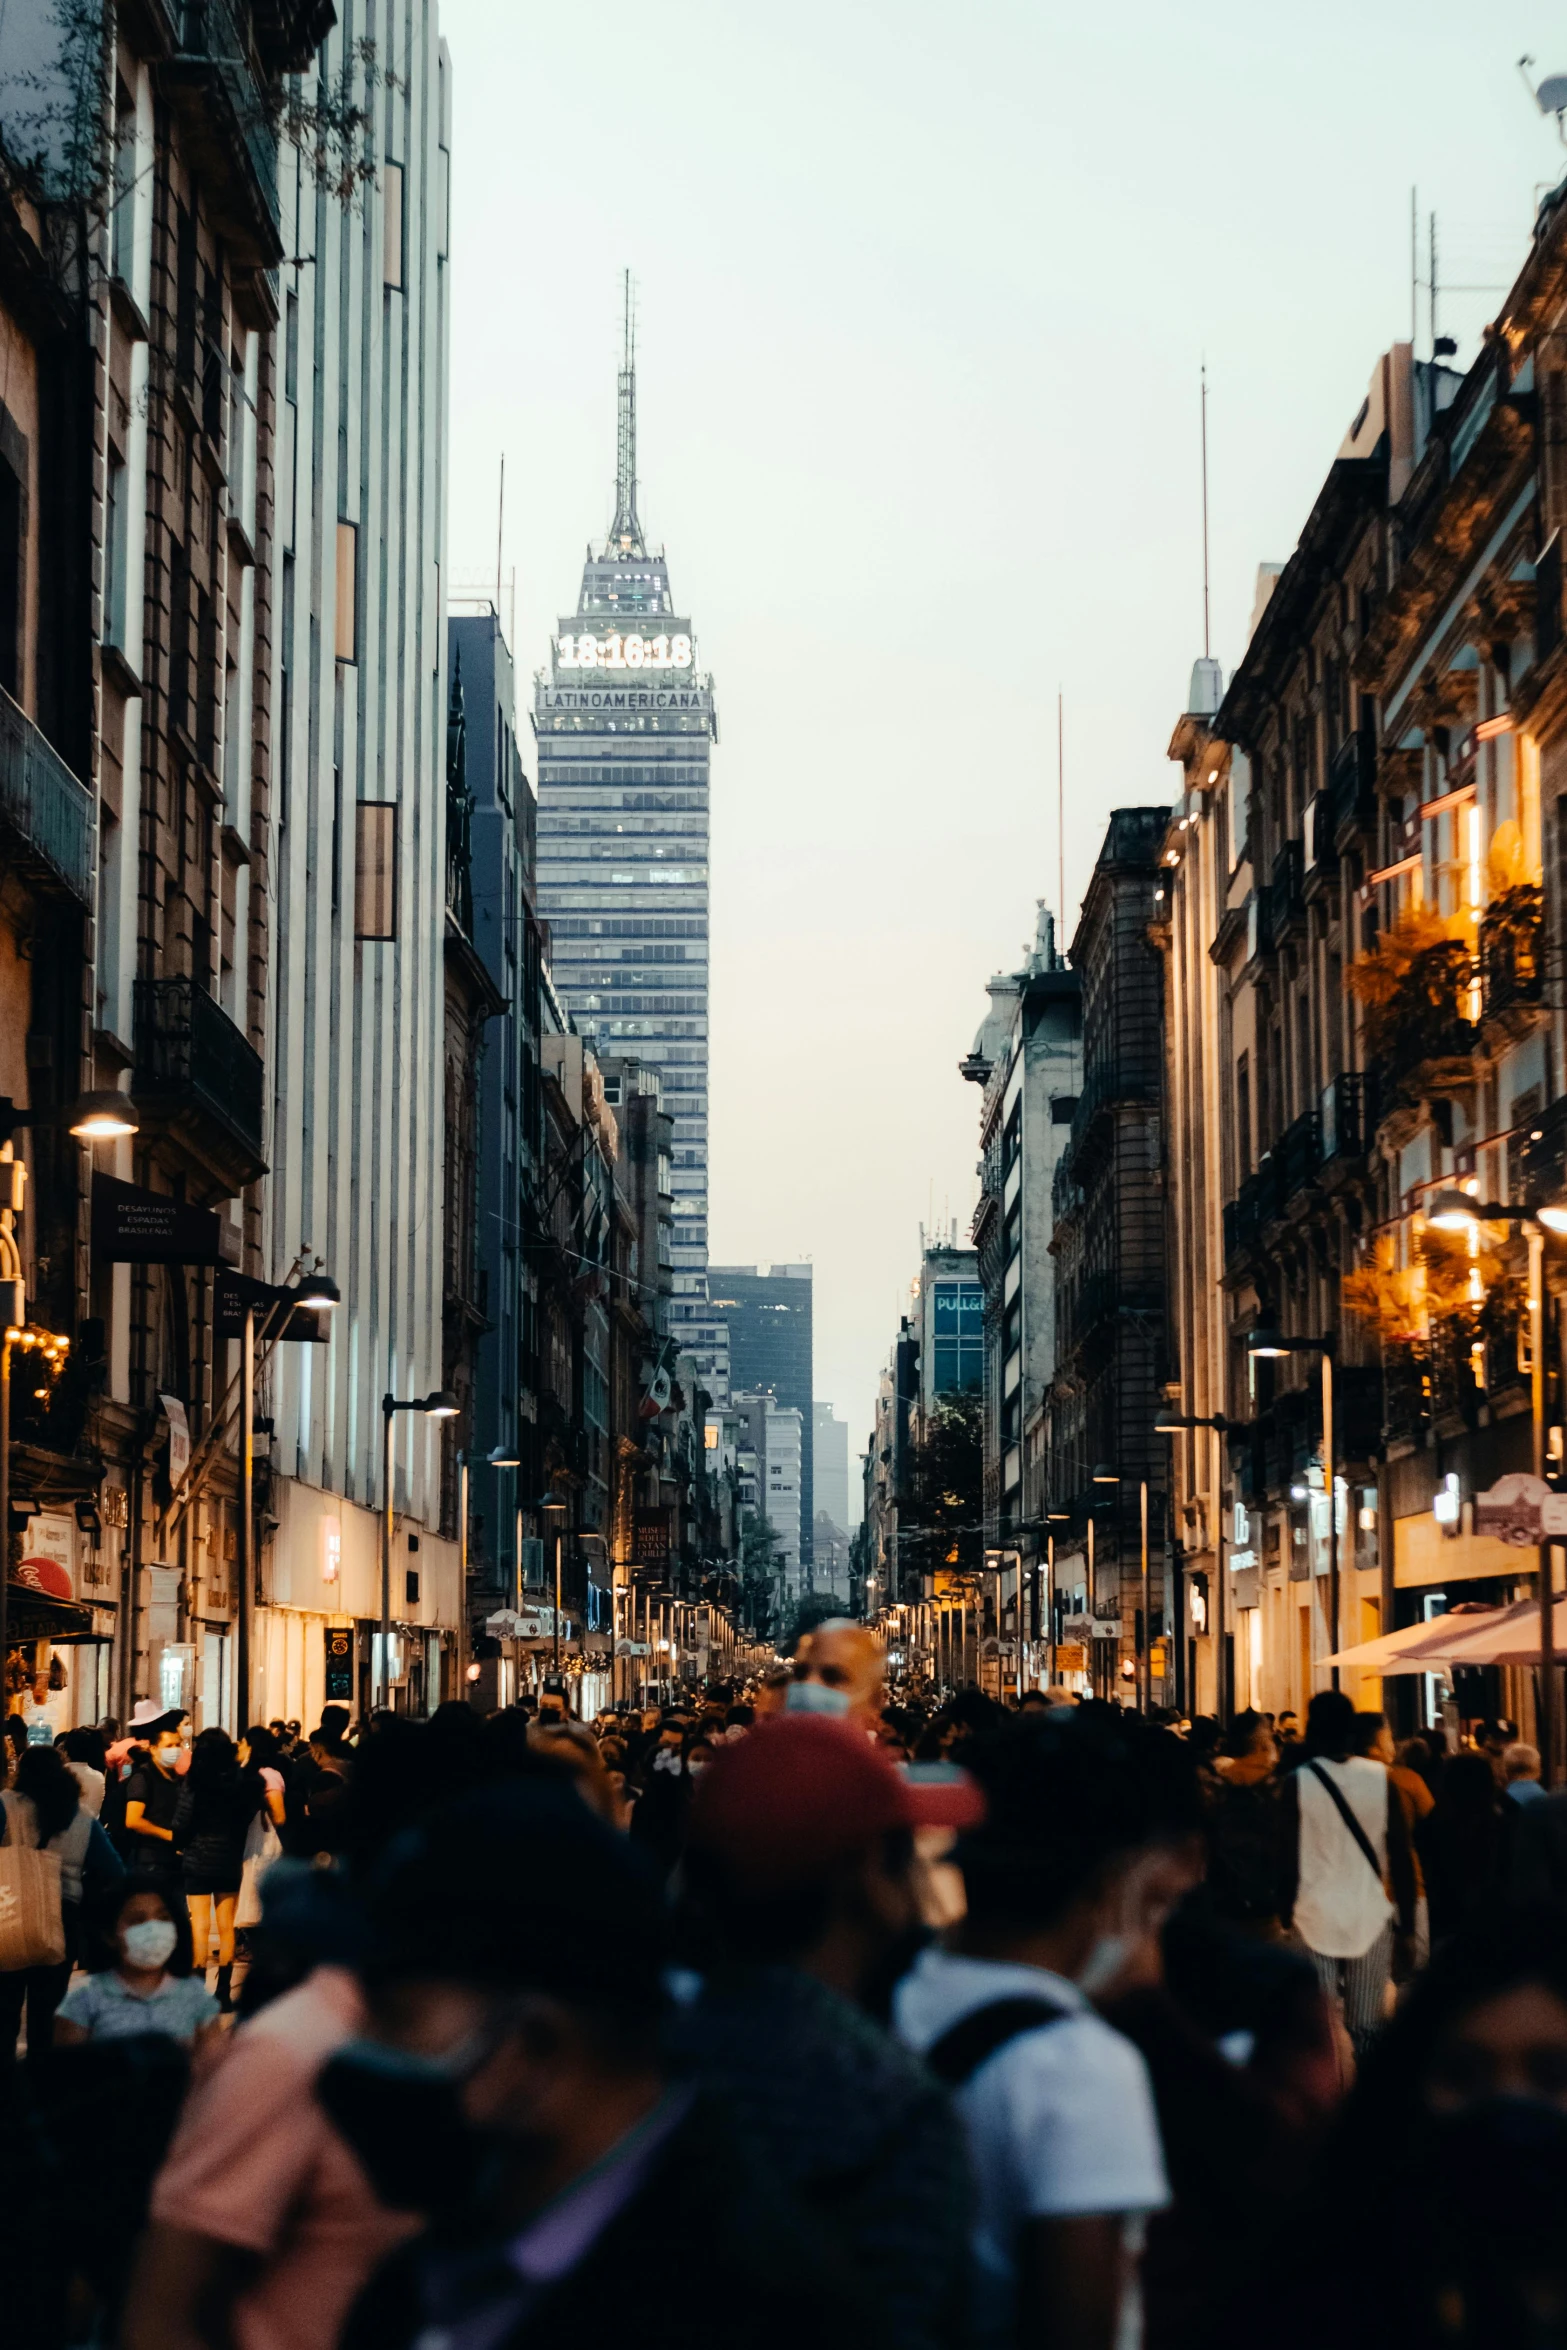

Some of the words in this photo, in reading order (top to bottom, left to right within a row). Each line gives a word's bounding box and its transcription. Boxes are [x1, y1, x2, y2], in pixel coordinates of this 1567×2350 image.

[558, 634, 692, 668] 18:16:18
[545, 693, 700, 708] LATINOAMERICANA
[117, 1204, 177, 1215] DESAYUNOS
[127, 1216, 170, 1224] ESPADAS
[118, 1226, 173, 1236] BRASILEÑAS
